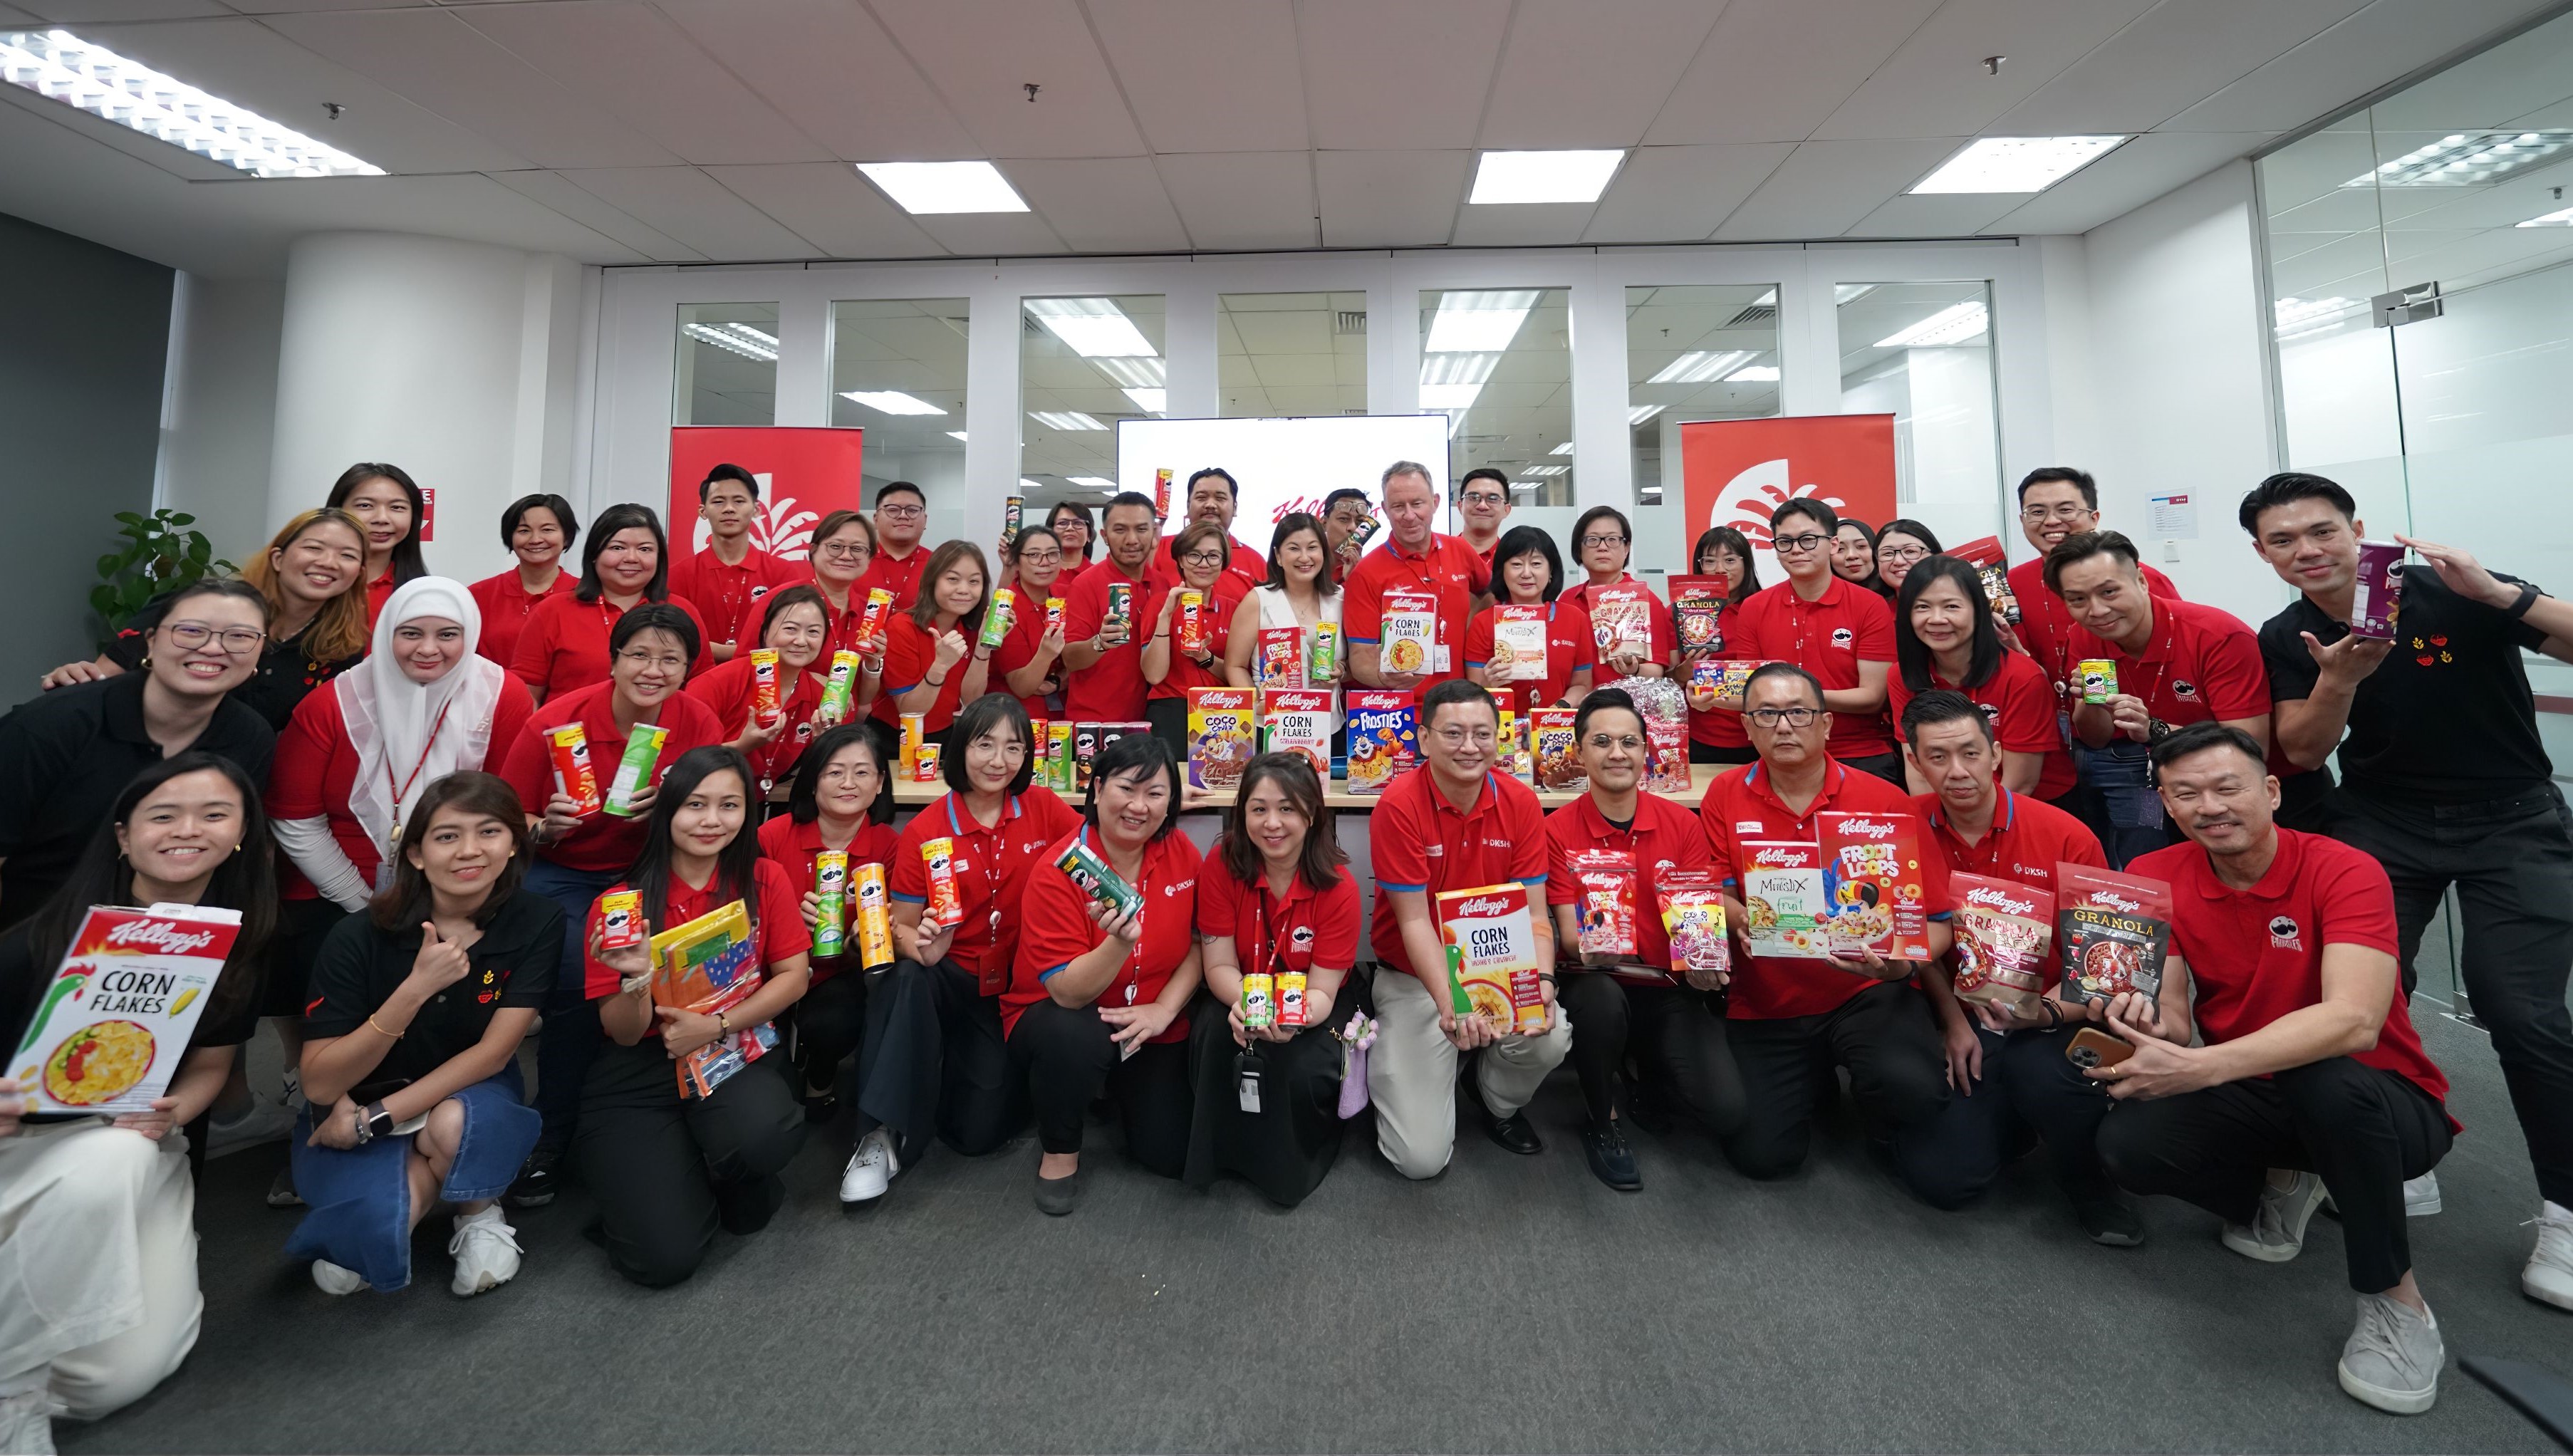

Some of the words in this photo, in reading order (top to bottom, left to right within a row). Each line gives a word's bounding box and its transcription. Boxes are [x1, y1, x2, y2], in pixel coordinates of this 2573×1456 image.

[1395, 619, 1420, 629] CORN
[1199, 692, 1244, 709] Kellogg's
[1276, 692, 1323, 711] Kellogg's
[1361, 694, 1400, 709] Kellogg's
[1205, 716, 1237, 726] COCO
[1283, 716, 1312, 728] CORN
[1361, 711, 1403, 732] FROSTIES
[1283, 728, 1312, 737] FLAKES
[1547, 732, 1573, 742] COCO
[1838, 818, 1896, 839] Kellogg's
[1755, 848, 1809, 868] Kellogg's
[1839, 843, 1896, 865] FROOT
[1846, 860, 1900, 878] LOOPS
[2024, 866, 2048, 878] DKSH
[1459, 897, 1509, 916] Kellogg's
[1966, 888, 2035, 915] Kellogg's
[2091, 891, 2140, 912] Kellogg's
[2074, 910, 2153, 937] GRANOLA
[107, 920, 216, 955] Kellogg's
[1471, 927, 1509, 945] CORN
[1473, 942, 1511, 958] FLAKES
[102, 970, 176, 996] CORN
[89, 994, 167, 1014] FLAKES
